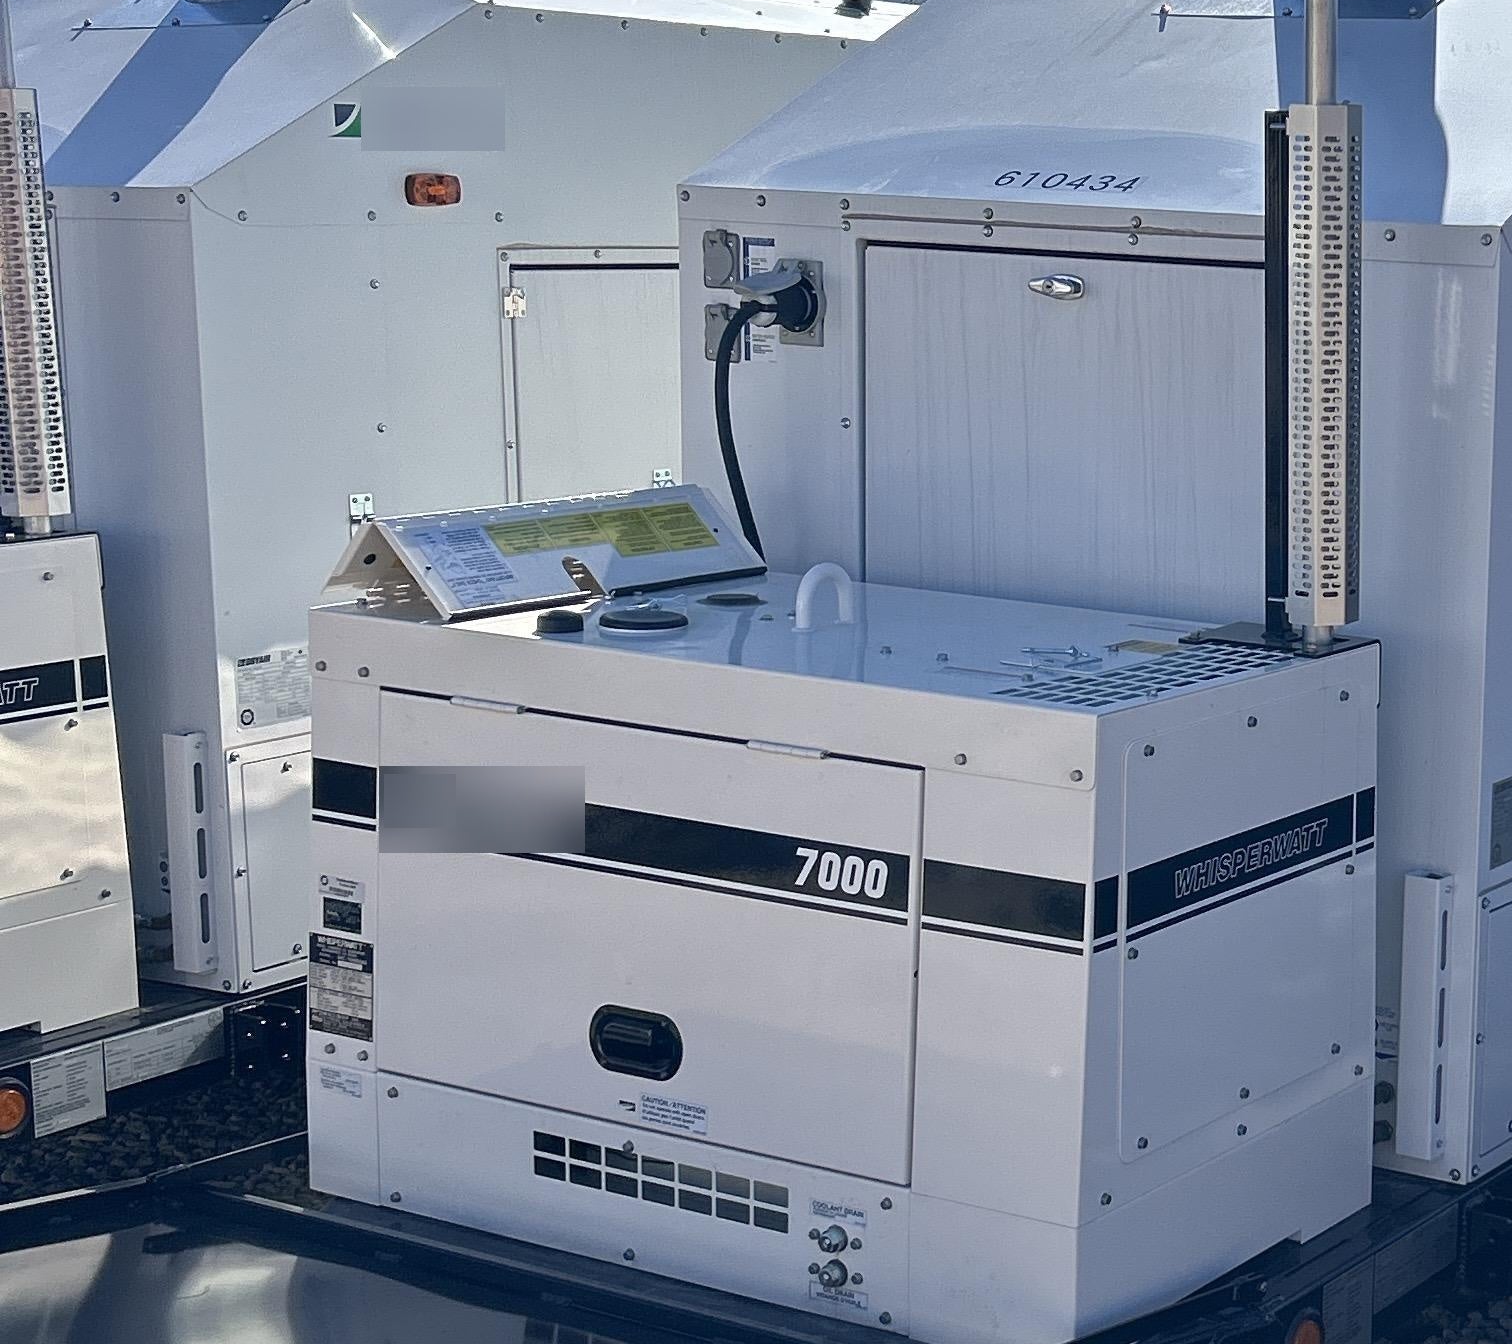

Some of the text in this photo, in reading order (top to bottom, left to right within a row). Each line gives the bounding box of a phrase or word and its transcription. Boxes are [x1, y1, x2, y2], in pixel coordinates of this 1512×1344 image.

[994, 170, 1141, 192] 610434
[794, 846, 889, 899] 7000
[1174, 817, 1329, 899] WHISPERWATT
